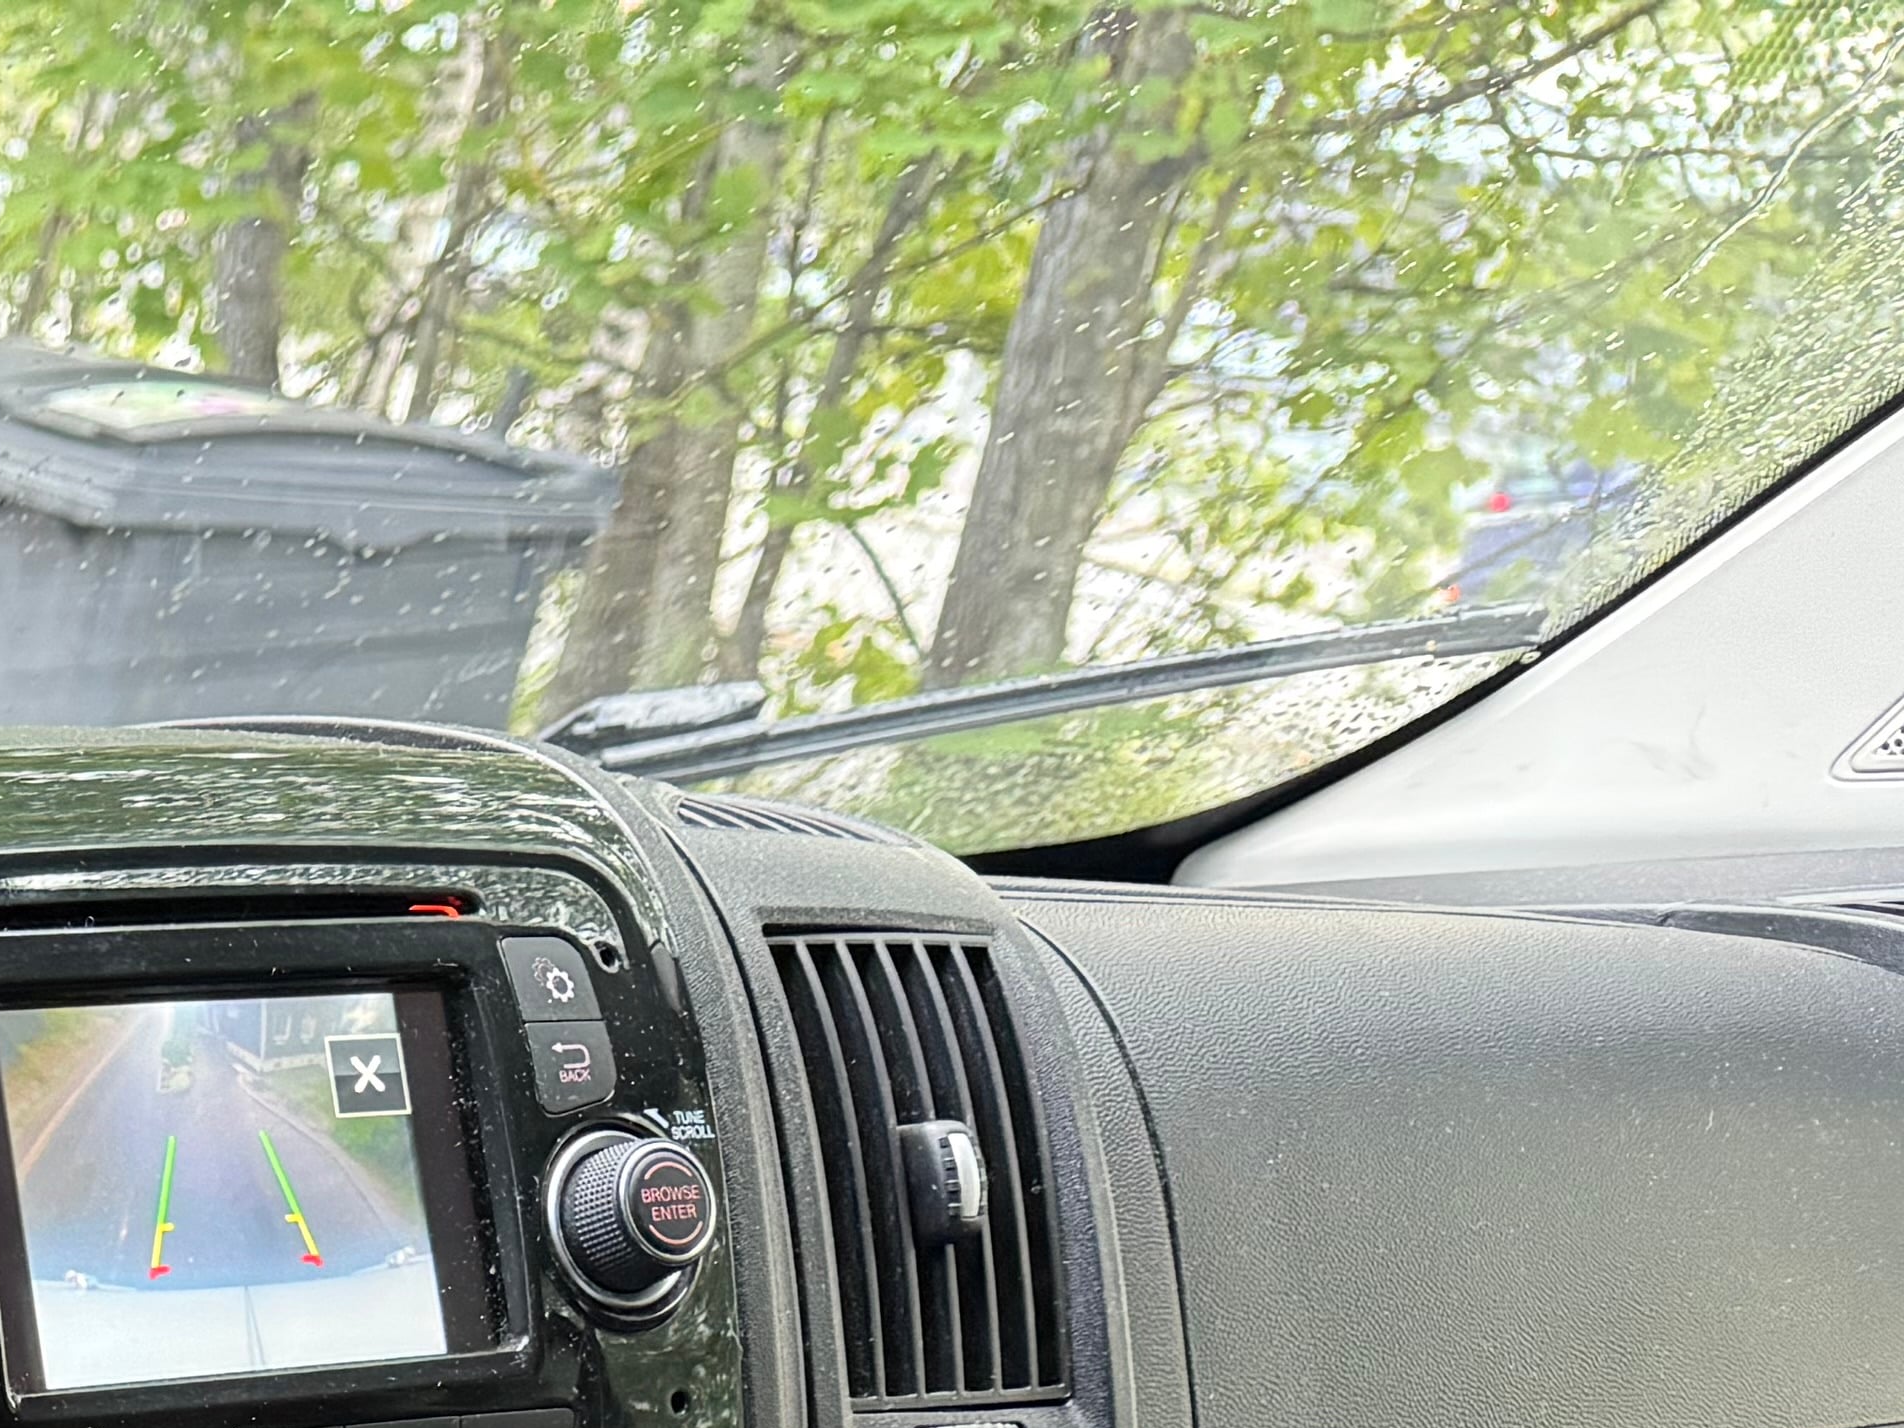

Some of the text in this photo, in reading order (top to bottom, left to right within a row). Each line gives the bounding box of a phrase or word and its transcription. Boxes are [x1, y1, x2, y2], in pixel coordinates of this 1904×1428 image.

[558, 1068, 592, 1083] BACK
[672, 1109, 706, 1124] TUNE
[671, 1123, 715, 1140] SCROLL
[641, 1184, 702, 1204] BROWSE
[651, 1203, 698, 1222] ENTER
